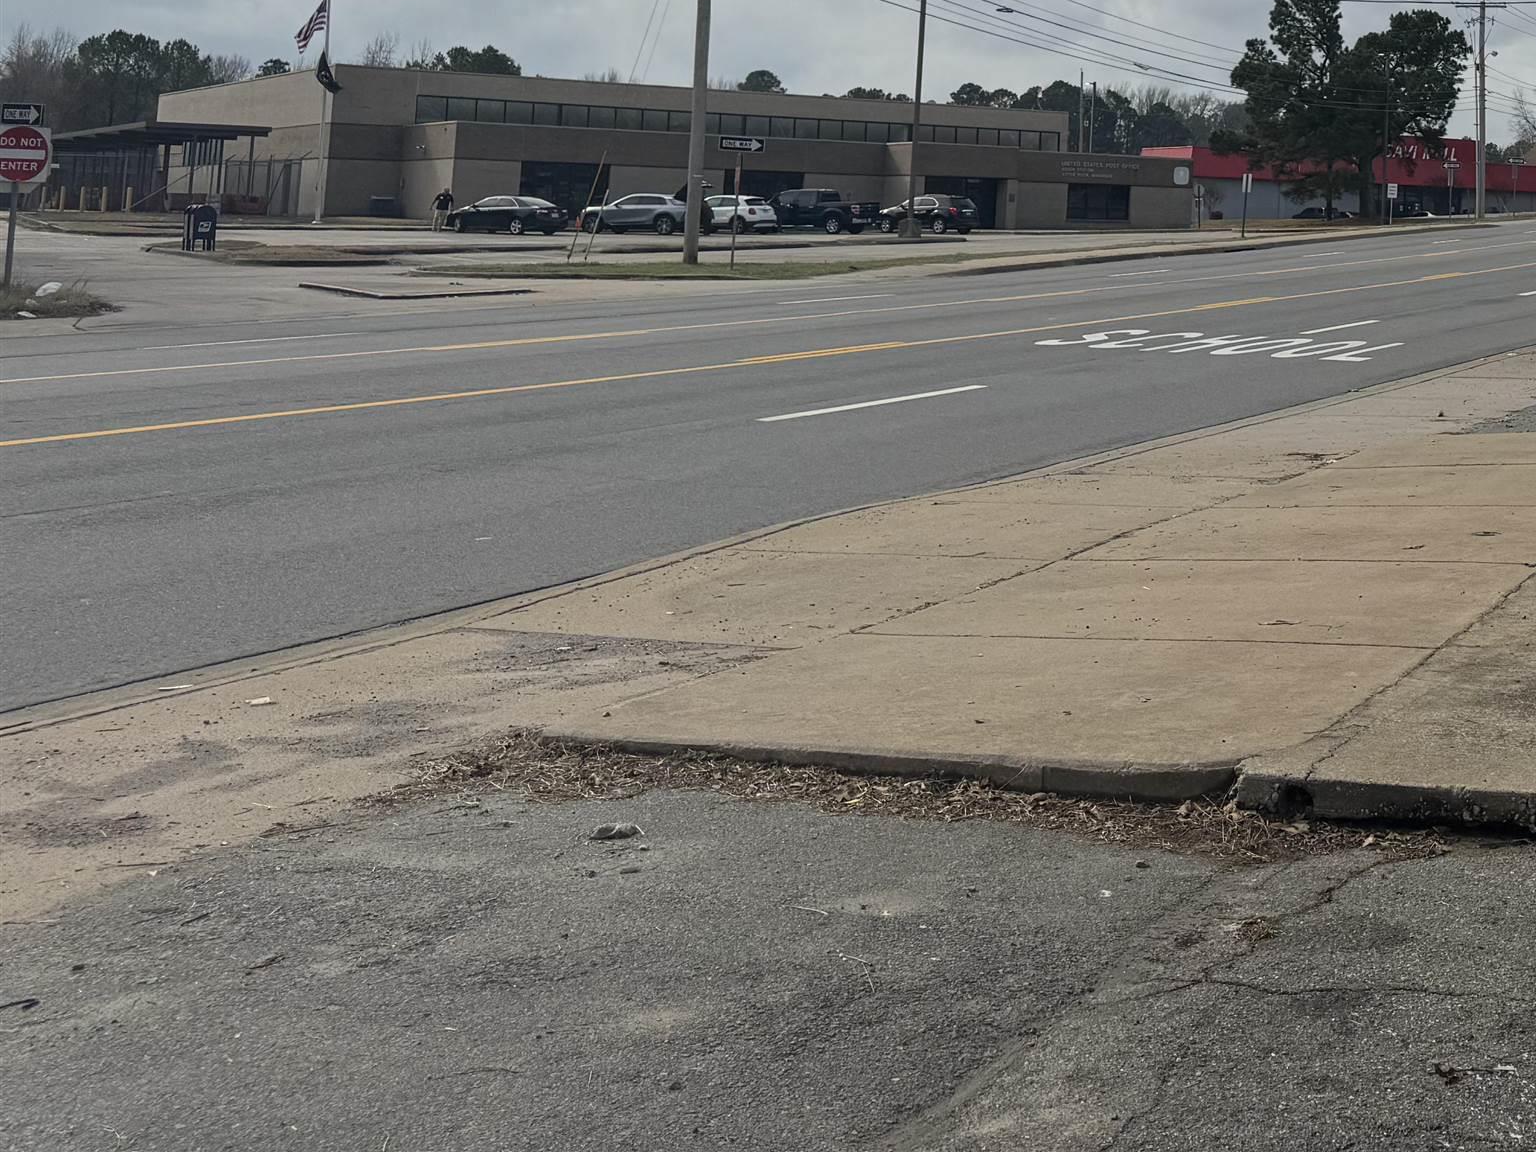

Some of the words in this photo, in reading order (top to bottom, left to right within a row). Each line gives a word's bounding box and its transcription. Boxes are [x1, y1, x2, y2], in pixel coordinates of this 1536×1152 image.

[0, 136, 16, 146] DO
[20, 138, 43, 147] NOT
[0, 161, 38, 171] ENTER
[1034, 329, 1405, 362] SCHOOL
